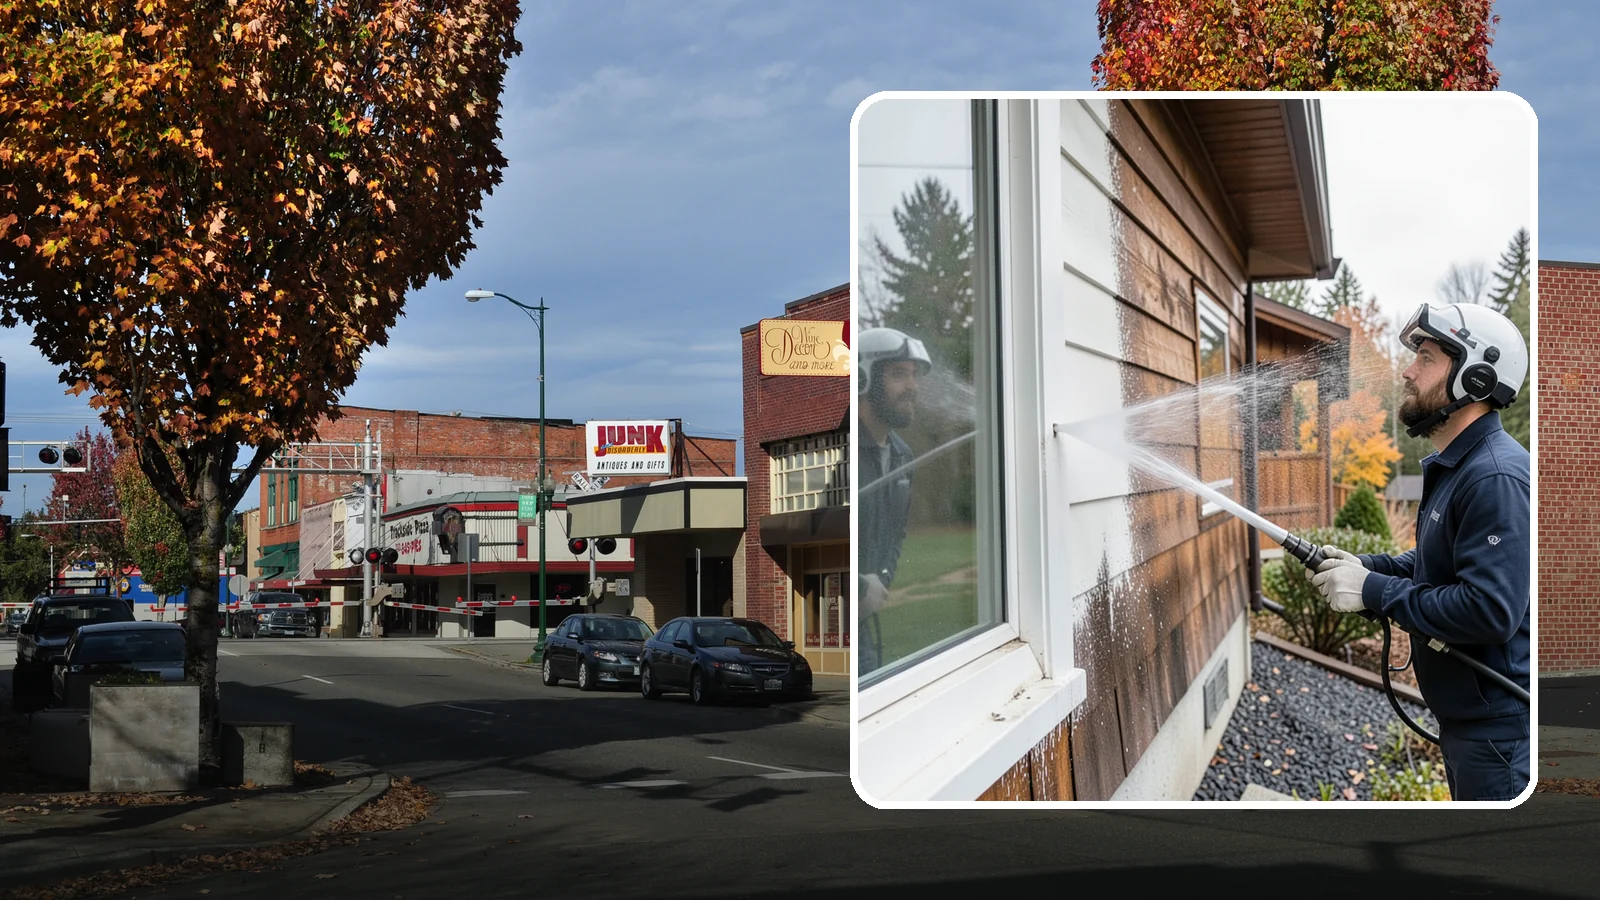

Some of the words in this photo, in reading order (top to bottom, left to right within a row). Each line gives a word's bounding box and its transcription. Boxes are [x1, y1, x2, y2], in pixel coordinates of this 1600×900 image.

[595, 425, 666, 457] JUNK
[607, 446, 646, 454] DISORDERLY
[596, 461, 628, 470] ANTIQUES
[631, 461, 644, 470] AND
[646, 460, 665, 469] GIFTS
[390, 521, 413, 539] Trackside
[414, 520, 429, 534] Pizza
